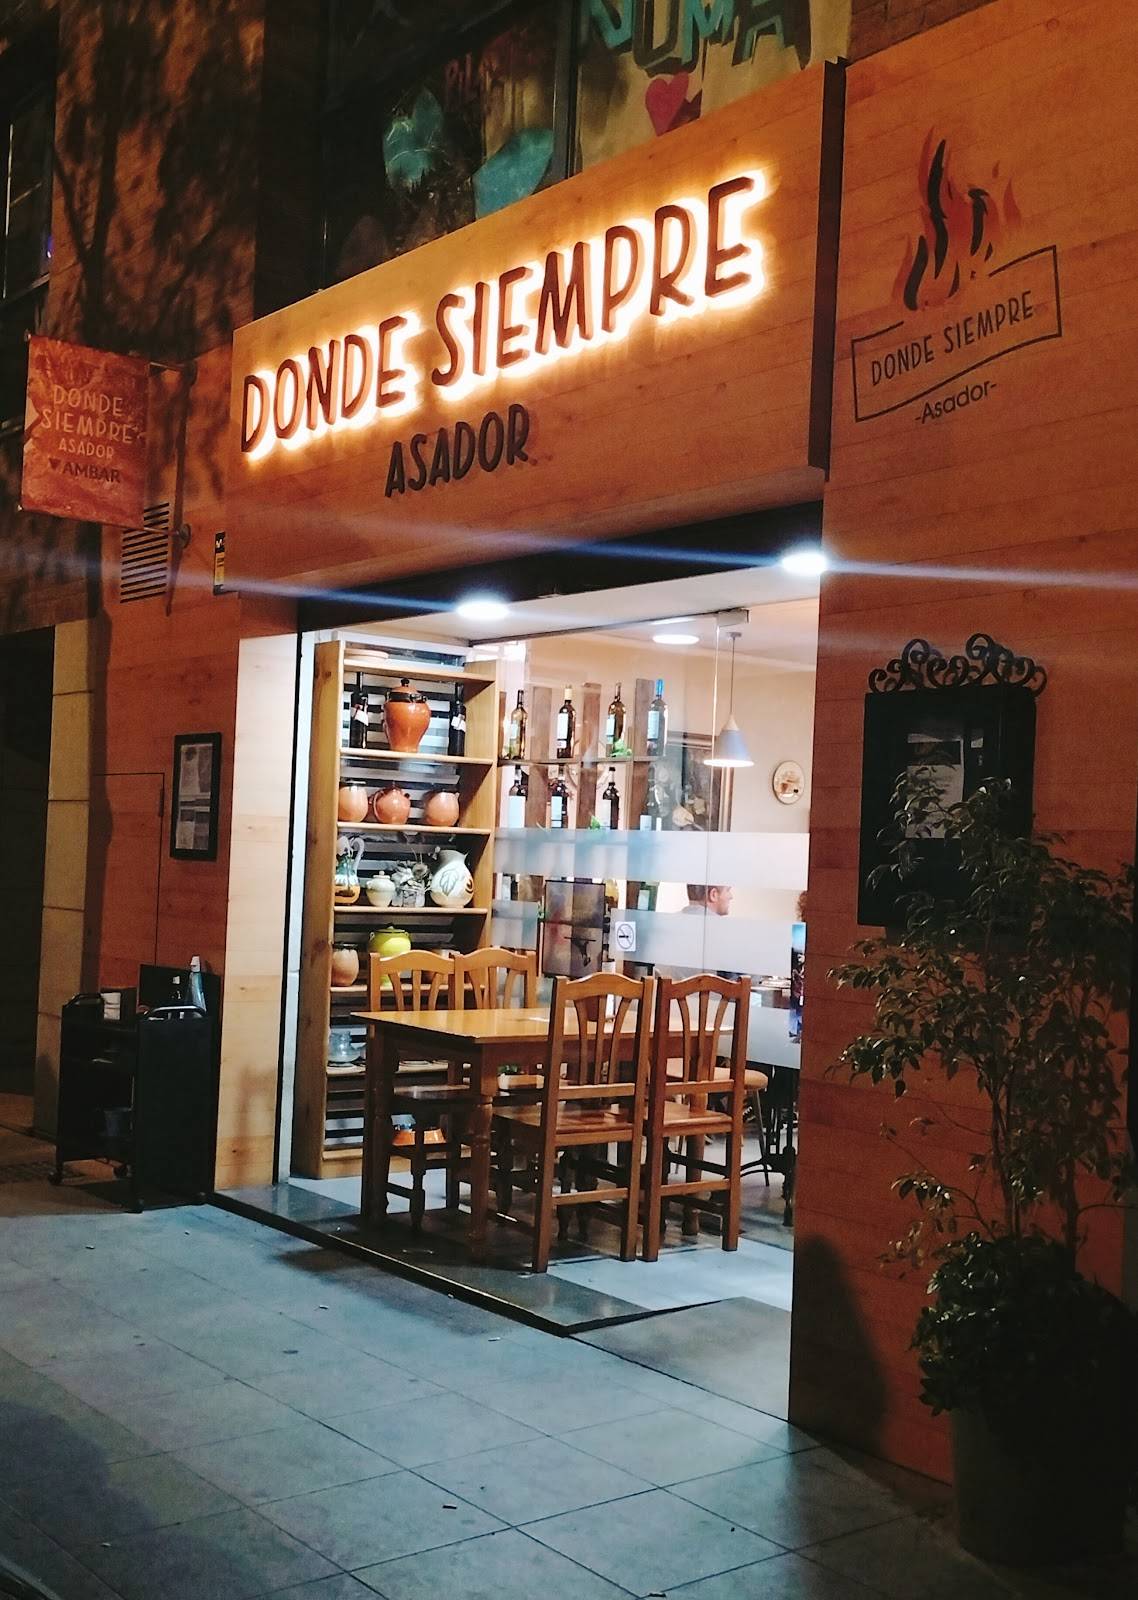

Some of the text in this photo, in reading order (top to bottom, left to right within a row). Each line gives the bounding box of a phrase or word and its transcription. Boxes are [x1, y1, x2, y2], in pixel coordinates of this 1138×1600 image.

[241, 176, 756, 452] DONDE SIEMPRE
[871, 290, 1034, 386] DONDE SIEMPRE
[53, 384, 124, 418] DONDE
[40, 408, 134, 444] SIEMPRE
[58, 438, 115, 460] ASADOR
[384, 403, 532, 498] ASADOR
[62, 461, 122, 484] AMBAR
